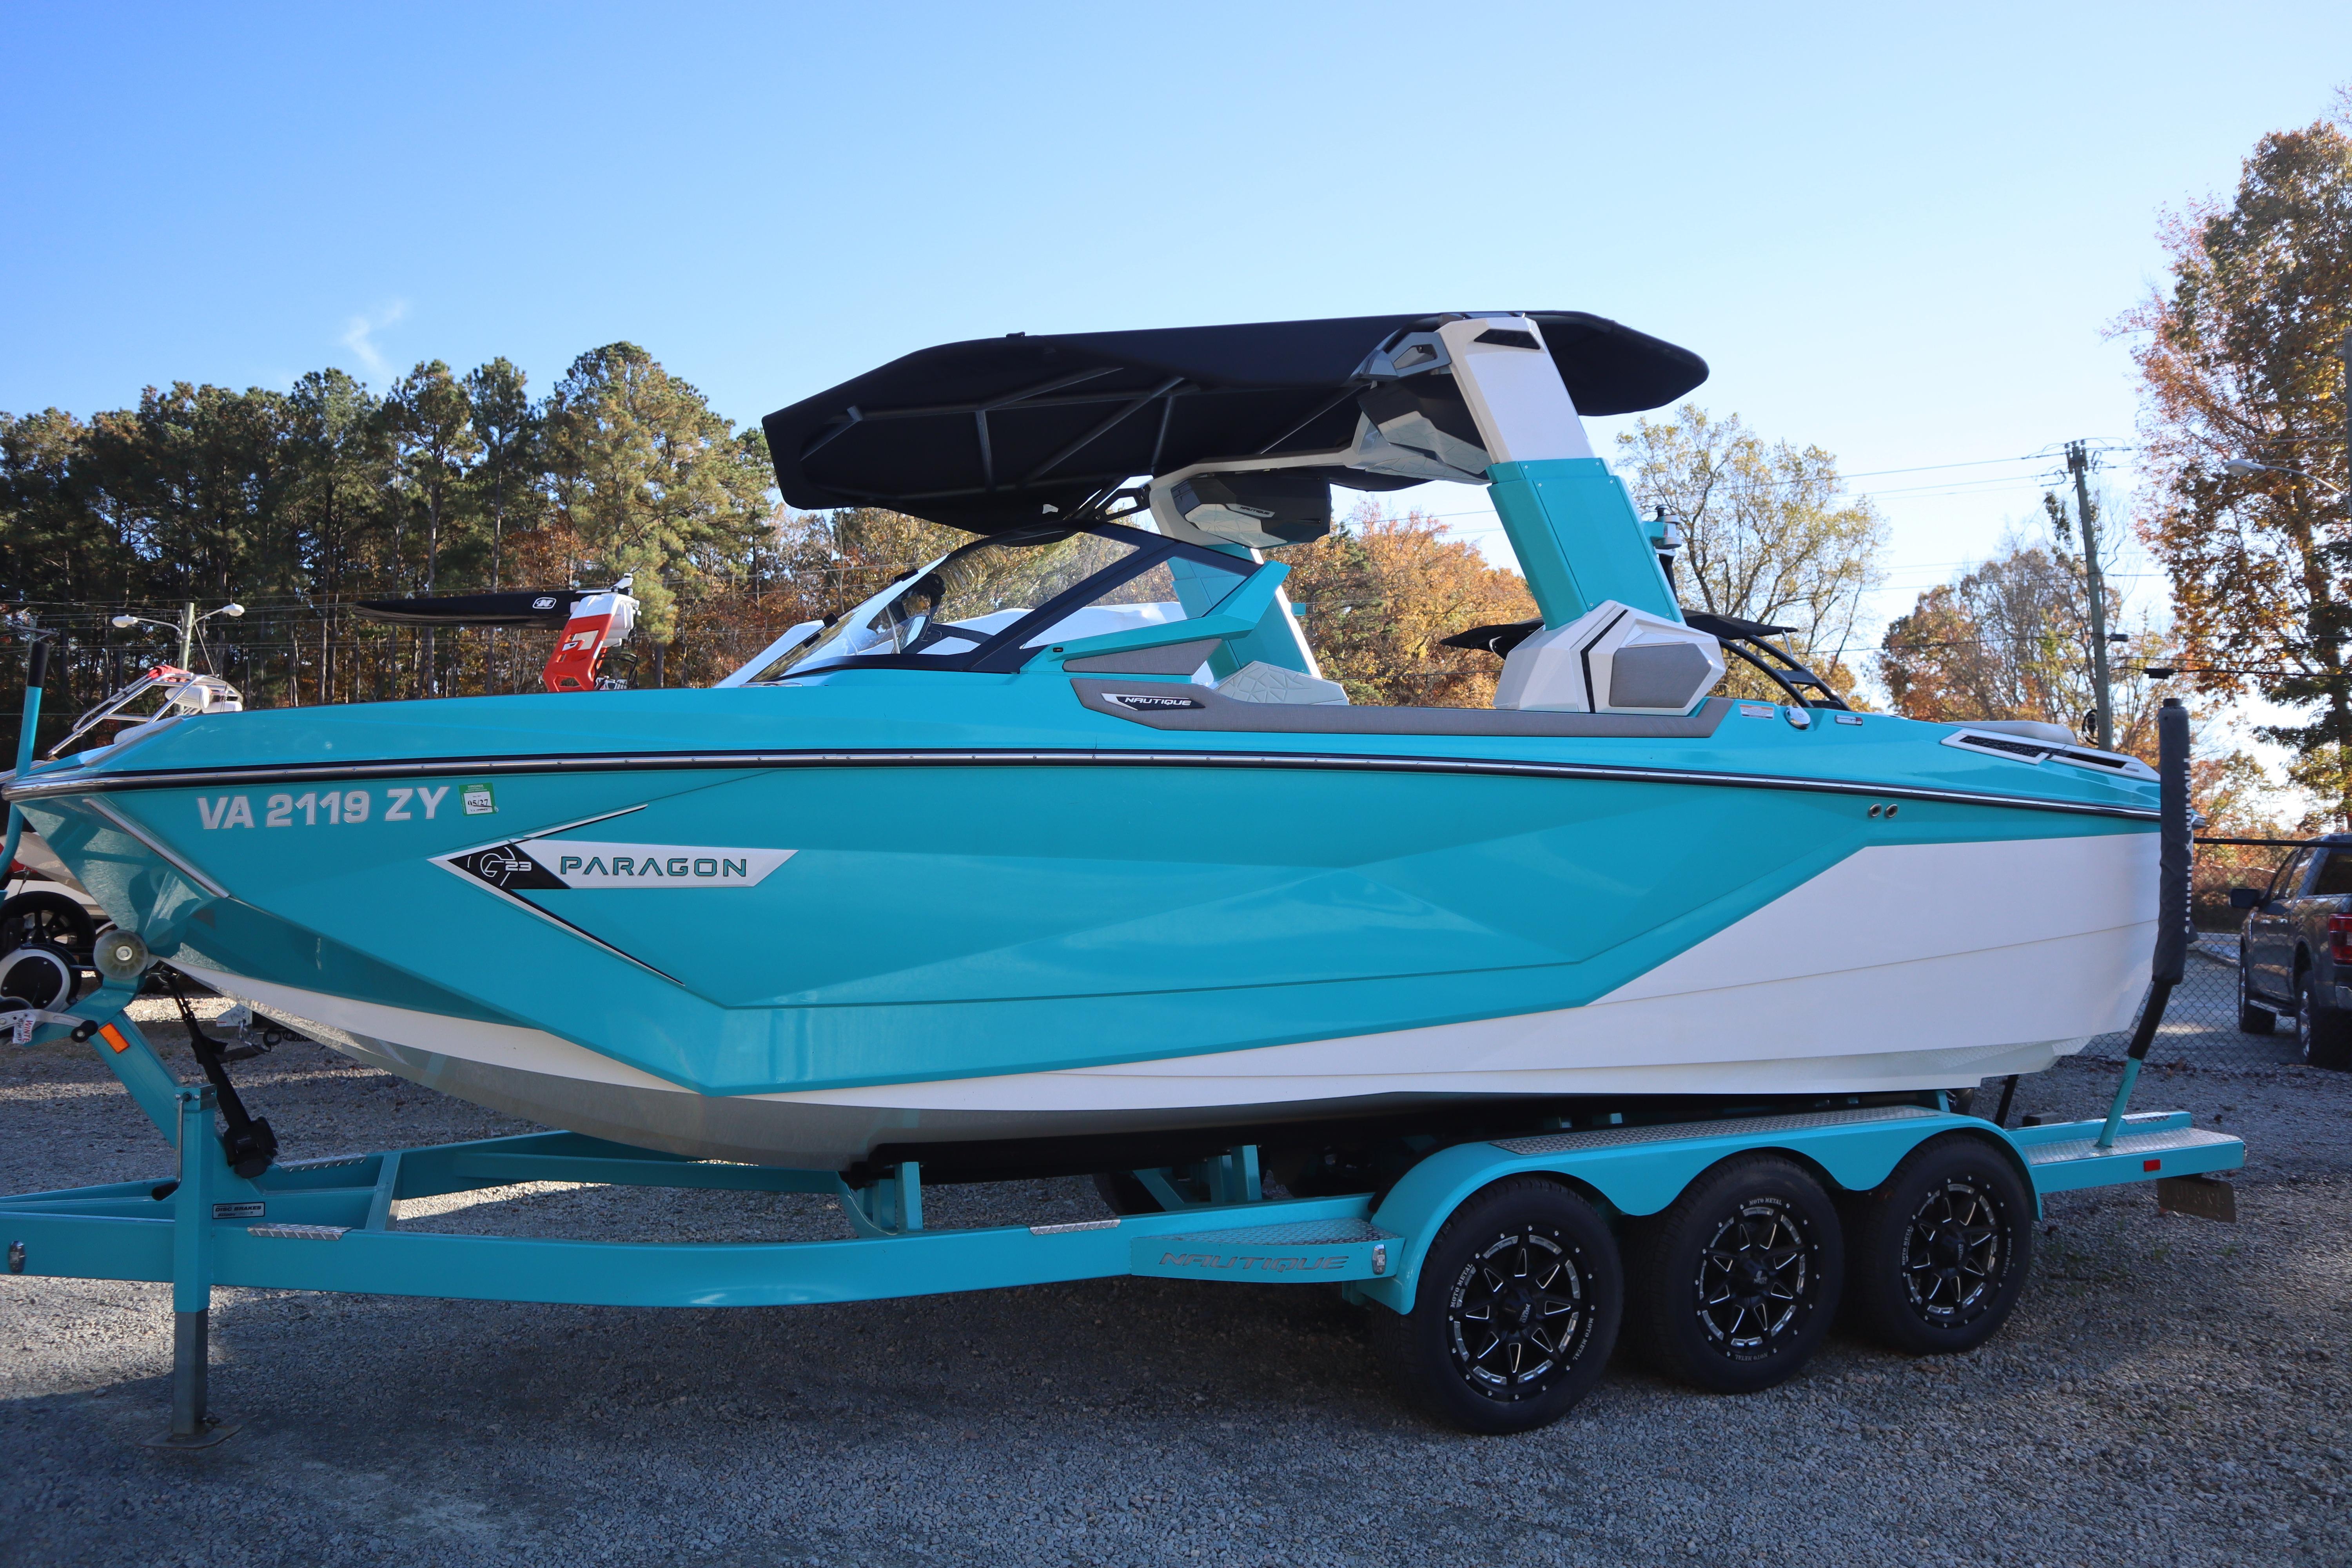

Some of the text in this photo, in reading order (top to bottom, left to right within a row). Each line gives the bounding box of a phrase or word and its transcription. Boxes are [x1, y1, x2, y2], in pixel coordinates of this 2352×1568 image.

[1240, 506, 1270, 515] NAUTIQUE
[1124, 697, 1192, 706] NAUTIQUE
[197, 796, 255, 829] VA
[266, 790, 370, 828] 2119
[385, 786, 450, 822] ZY
[559, 856, 746, 878] PARAGON
[1158, 1252, 1349, 1273] NAUTIQUE
[1450, 1263, 1473, 1308] MOTO METAL
[1572, 1318, 1594, 1360] MOTO METAL
